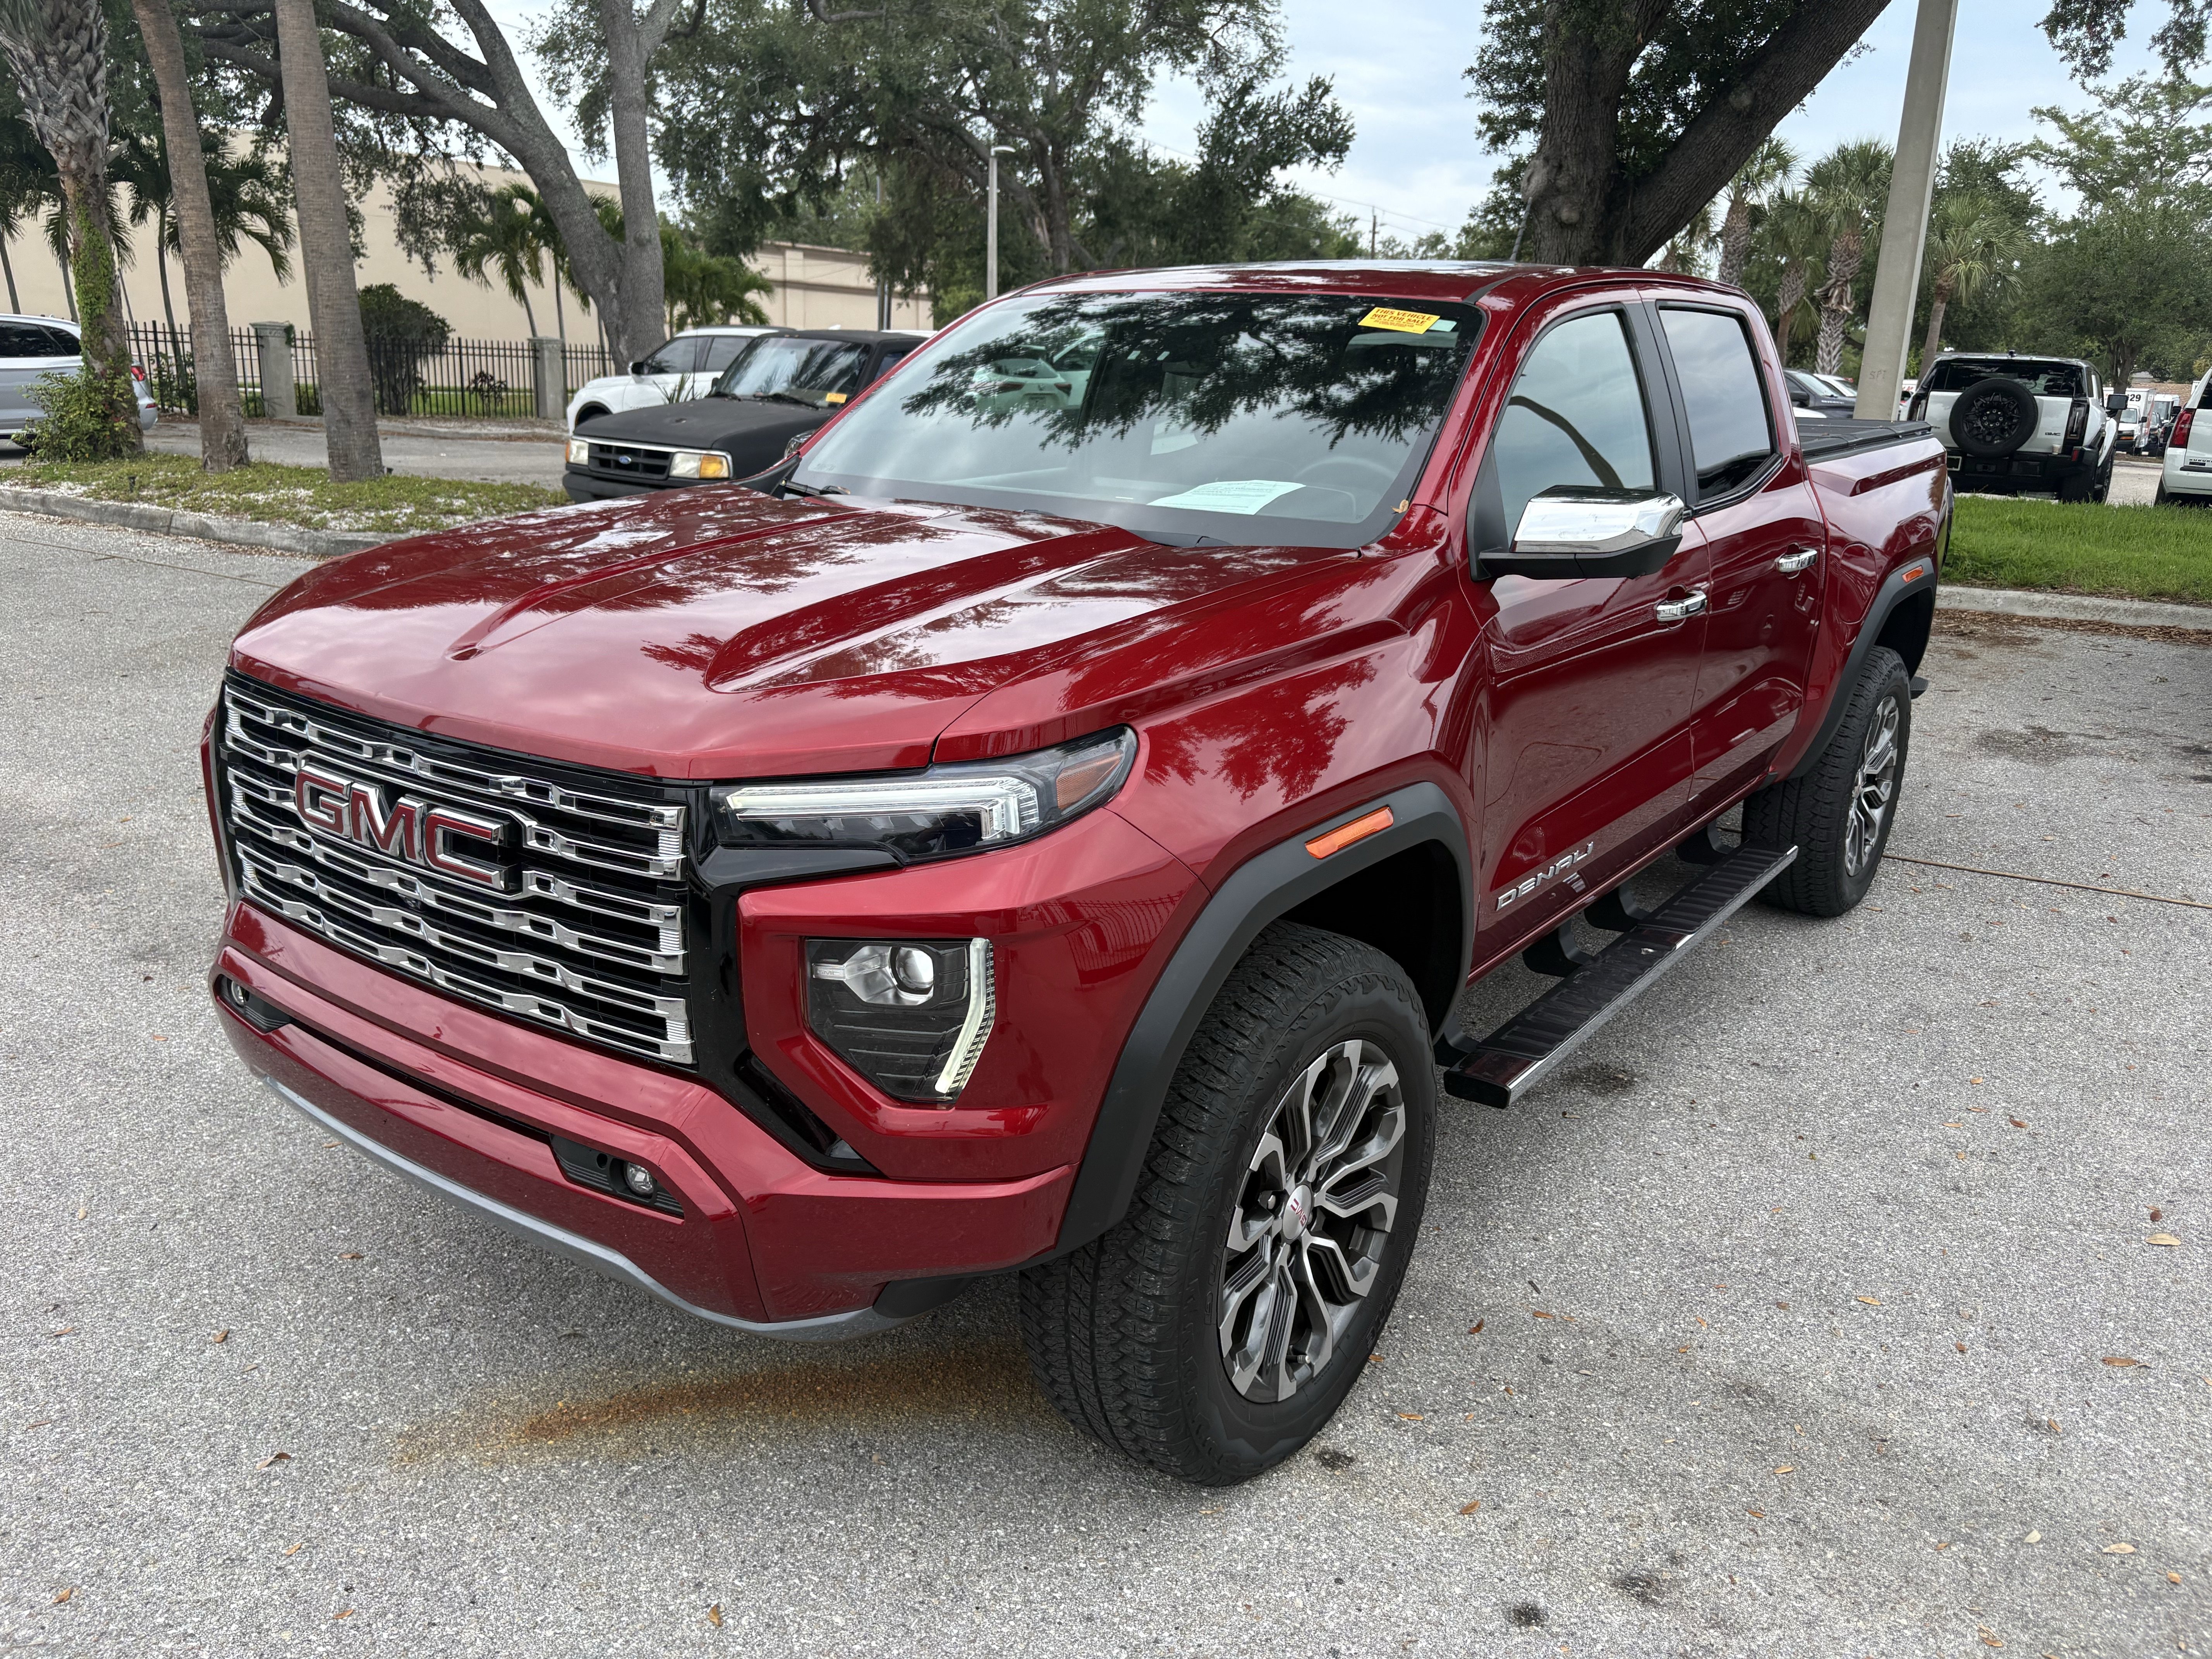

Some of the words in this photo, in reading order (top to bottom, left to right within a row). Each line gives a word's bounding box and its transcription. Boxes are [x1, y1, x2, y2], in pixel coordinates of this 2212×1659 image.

[1397, 311, 1433, 321] VEHICLE
[295, 765, 504, 890] GMC
[1496, 842, 1594, 911] DENALI
[1290, 1198, 1307, 1227] GMC
[1366, 1112, 1432, 1349] BRIDGESTONE
